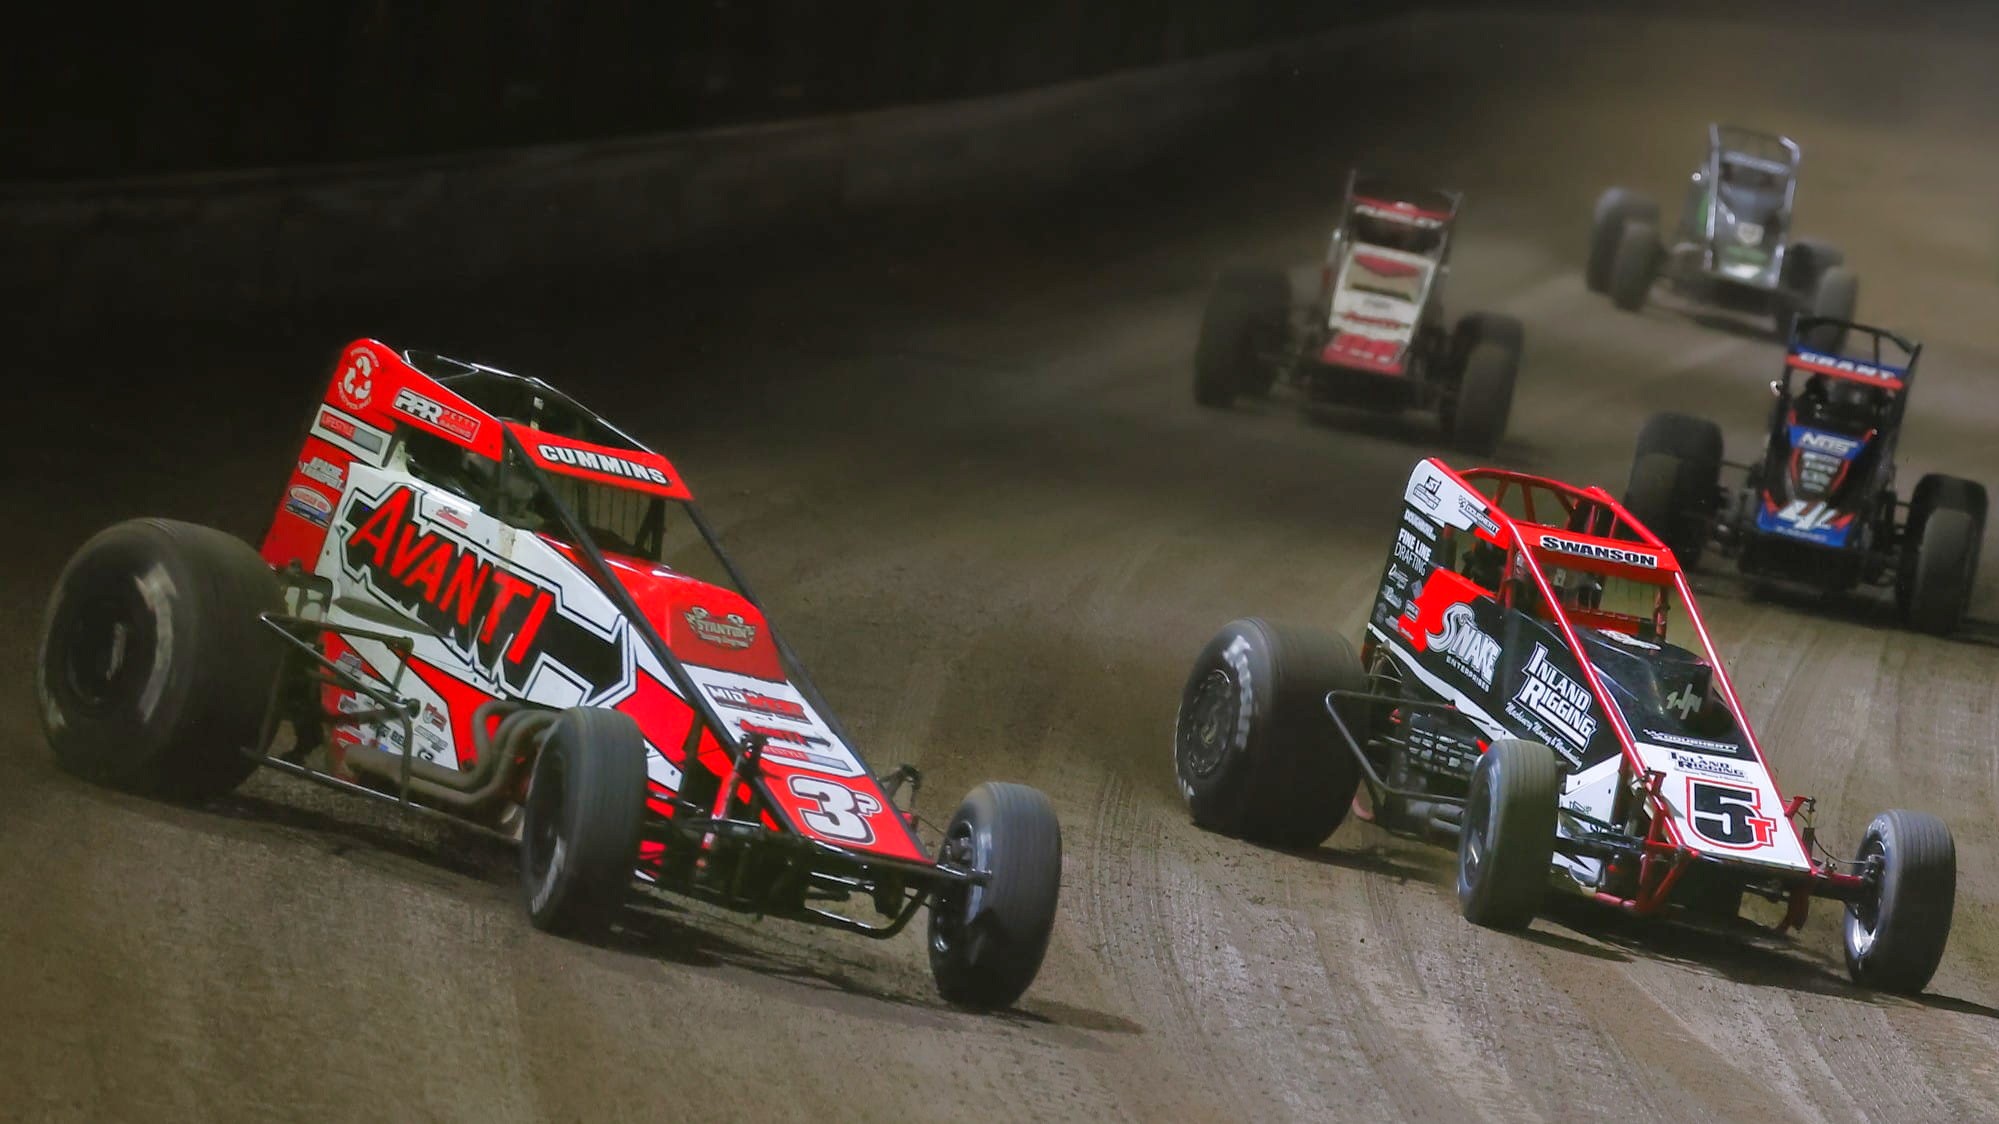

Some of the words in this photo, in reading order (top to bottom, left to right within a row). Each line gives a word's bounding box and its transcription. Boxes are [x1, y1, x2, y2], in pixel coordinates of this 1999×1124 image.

[537, 444, 668, 485] CUMMINS
[1394, 542, 1427, 576] DRAFTING
[1398, 528, 1416, 551] FINE
[1415, 540, 1431, 562] LINE
[1541, 536, 1656, 567] SWANSON
[348, 486, 551, 665] AVANTI
[1425, 602, 1502, 685] SNAKE
[1446, 655, 1490, 693] ENTERPRISES
[1527, 643, 1590, 712] INLAND
[1519, 676, 1595, 738] RIGGING
[1671, 752, 1730, 769] INLAND
